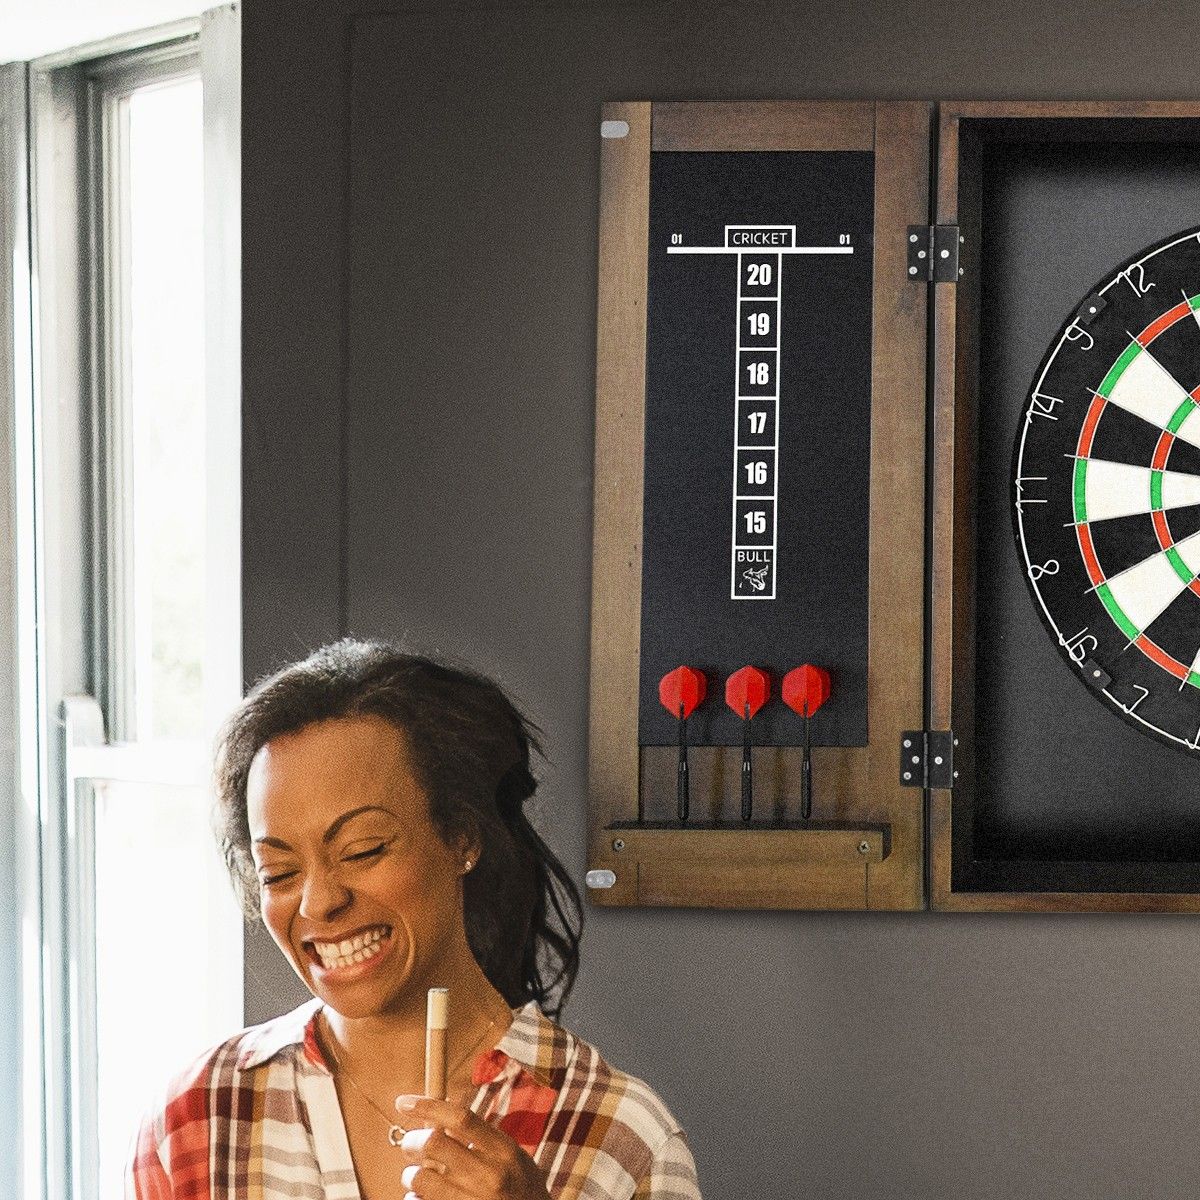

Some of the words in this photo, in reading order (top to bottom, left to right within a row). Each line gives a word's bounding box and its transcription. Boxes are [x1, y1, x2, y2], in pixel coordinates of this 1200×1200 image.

[671, 233, 683, 245] 01
[732, 232, 789, 245] CRICKET
[839, 233, 851, 245] 01
[746, 263, 772, 287] 20
[1116, 263, 1156, 298] 12
[747, 312, 770, 336] 19
[1065, 323, 1095, 351] 9
[746, 362, 770, 386] 18
[1025, 392, 1064, 424] 14
[747, 411, 767, 435] 17
[744, 461, 768, 485] 16
[1015, 476, 1048, 514] 11
[743, 510, 767, 534] 15
[737, 550, 771, 563] BULL
[1027, 559, 1060, 581] 8
[1058, 626, 1098, 662] 16
[1122, 684, 1149, 714] 7
